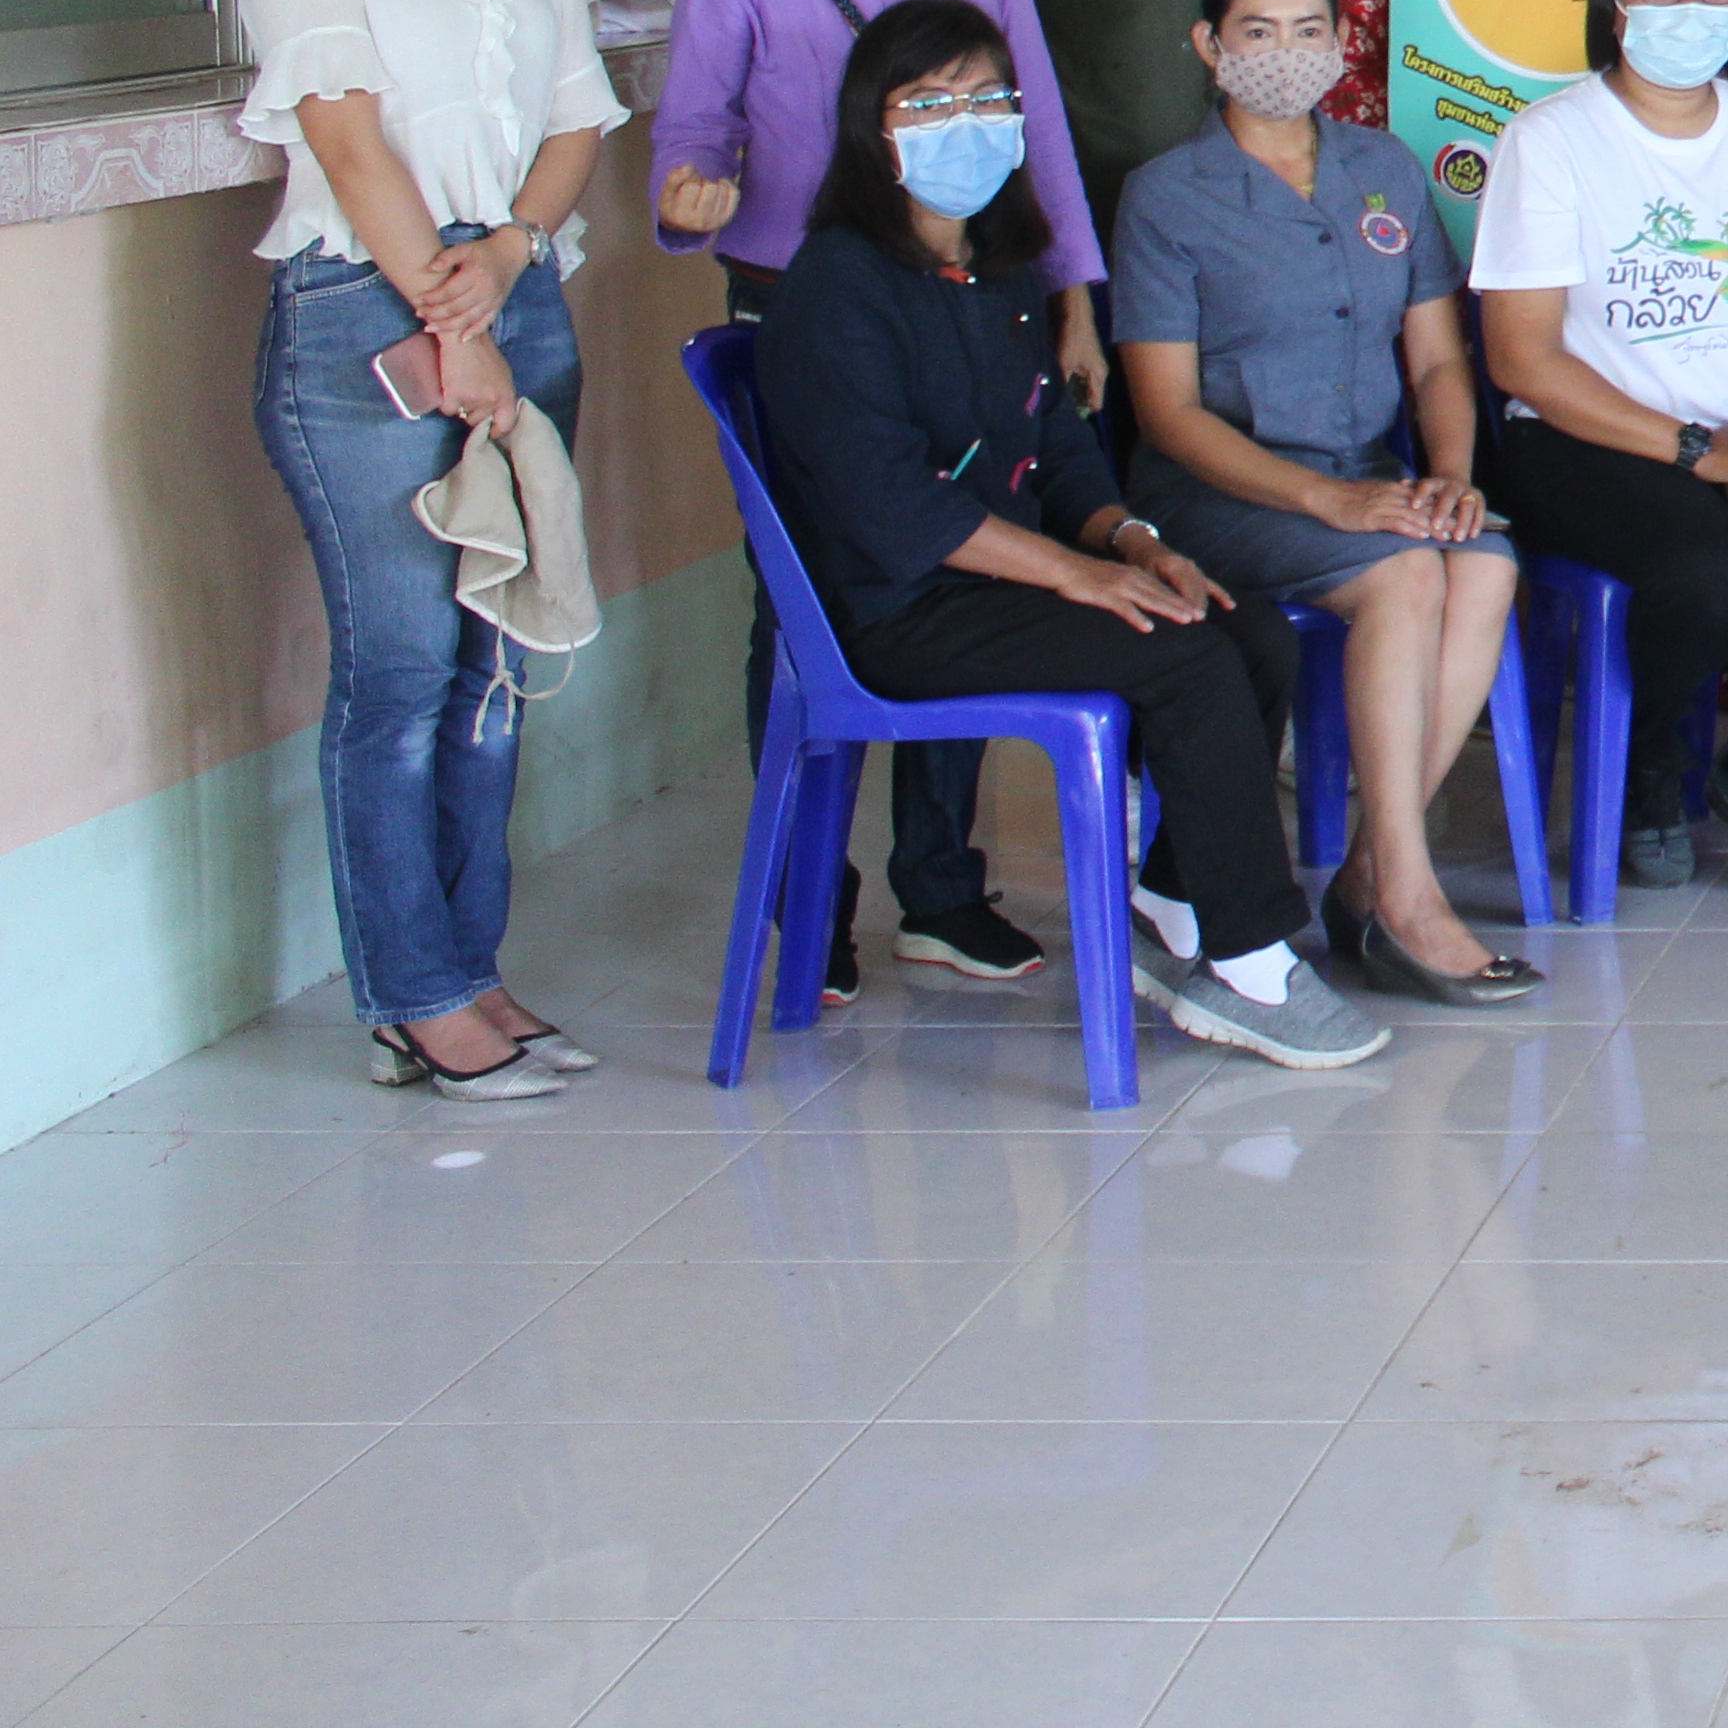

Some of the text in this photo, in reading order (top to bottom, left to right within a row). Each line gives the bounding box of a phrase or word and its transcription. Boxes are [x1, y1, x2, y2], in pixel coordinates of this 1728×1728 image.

[1403, 45, 1528, 114] โครงการเสริมสร้าง
[1436, 98, 1505, 137] ชุมชนท่อง
[1606, 257, 1722, 291] บ้านสวน
[1605, 285, 1718, 328] กล้วย
